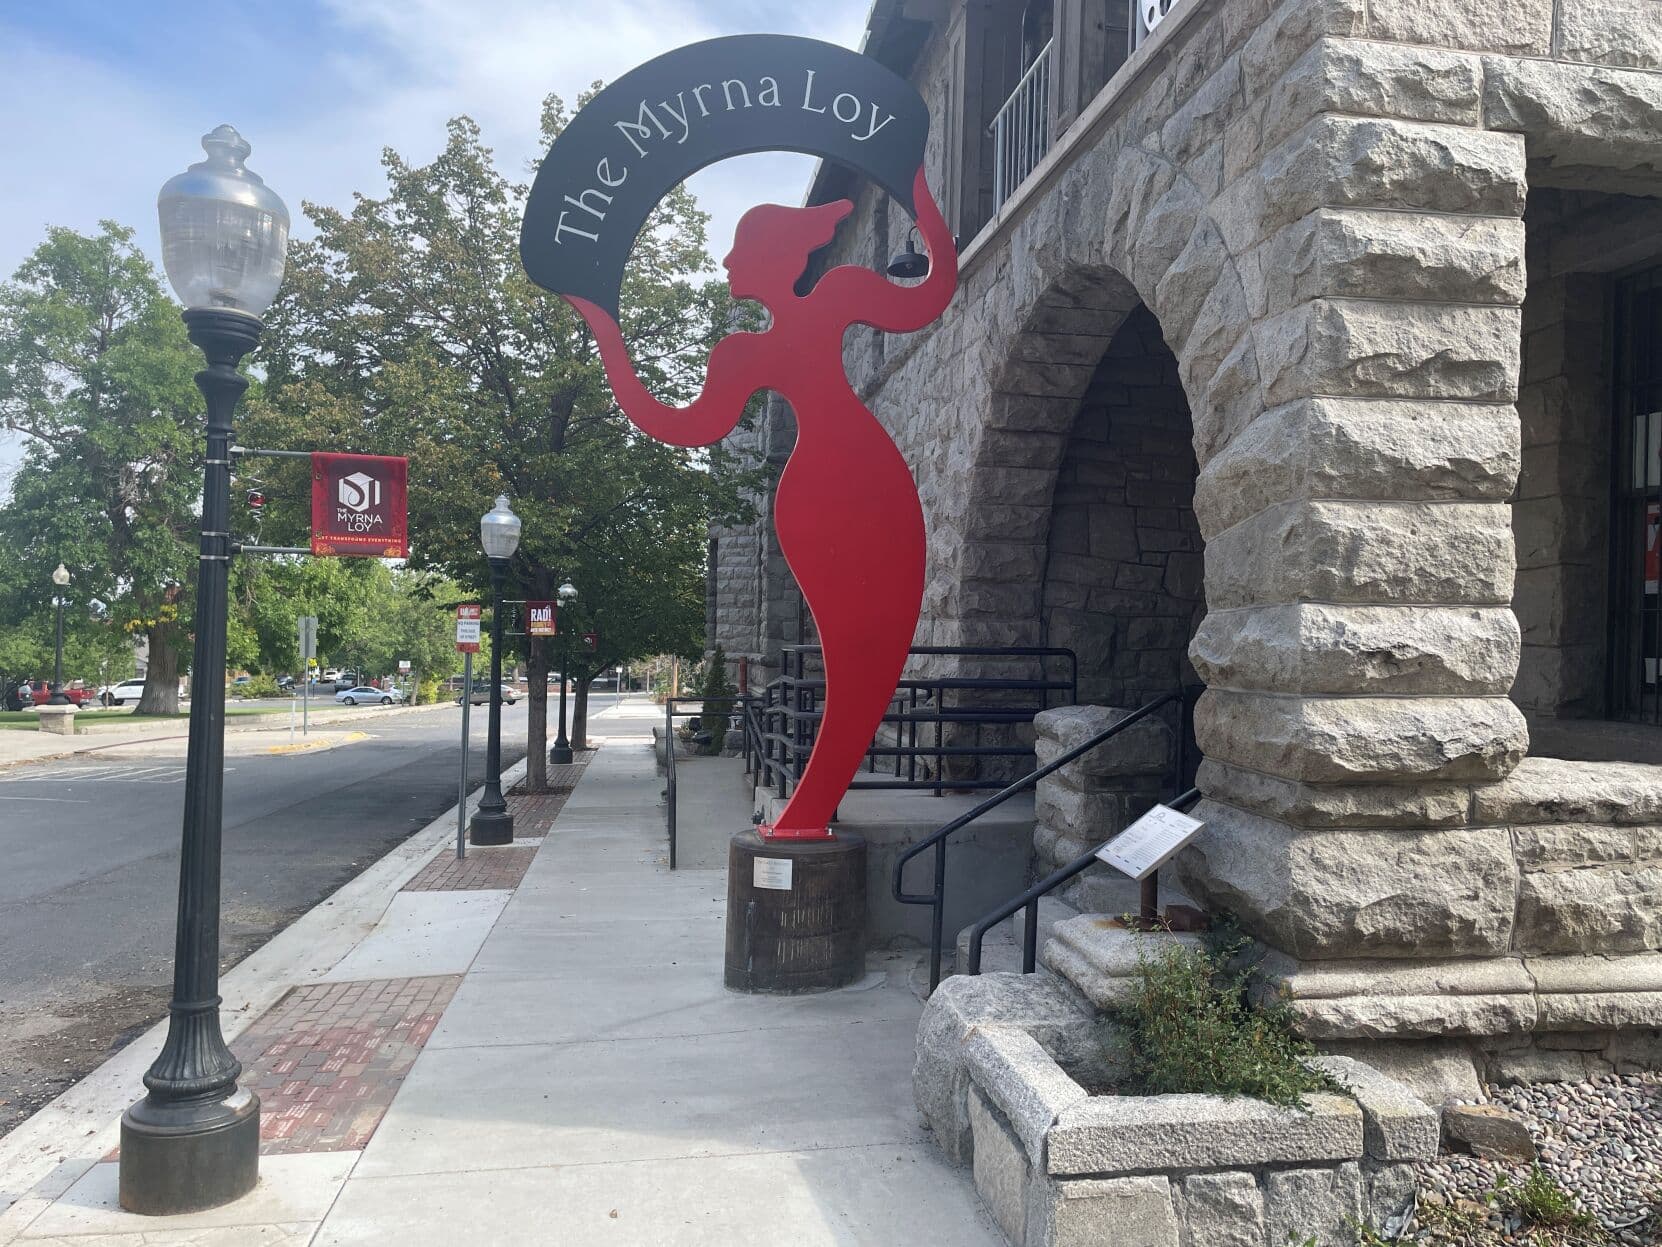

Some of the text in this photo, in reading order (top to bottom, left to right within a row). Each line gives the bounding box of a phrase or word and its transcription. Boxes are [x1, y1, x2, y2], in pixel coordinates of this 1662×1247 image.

[554, 69, 896, 245] The Myrna Loy
[337, 513, 383, 524] MYRNA
[348, 522, 372, 532] LOY
